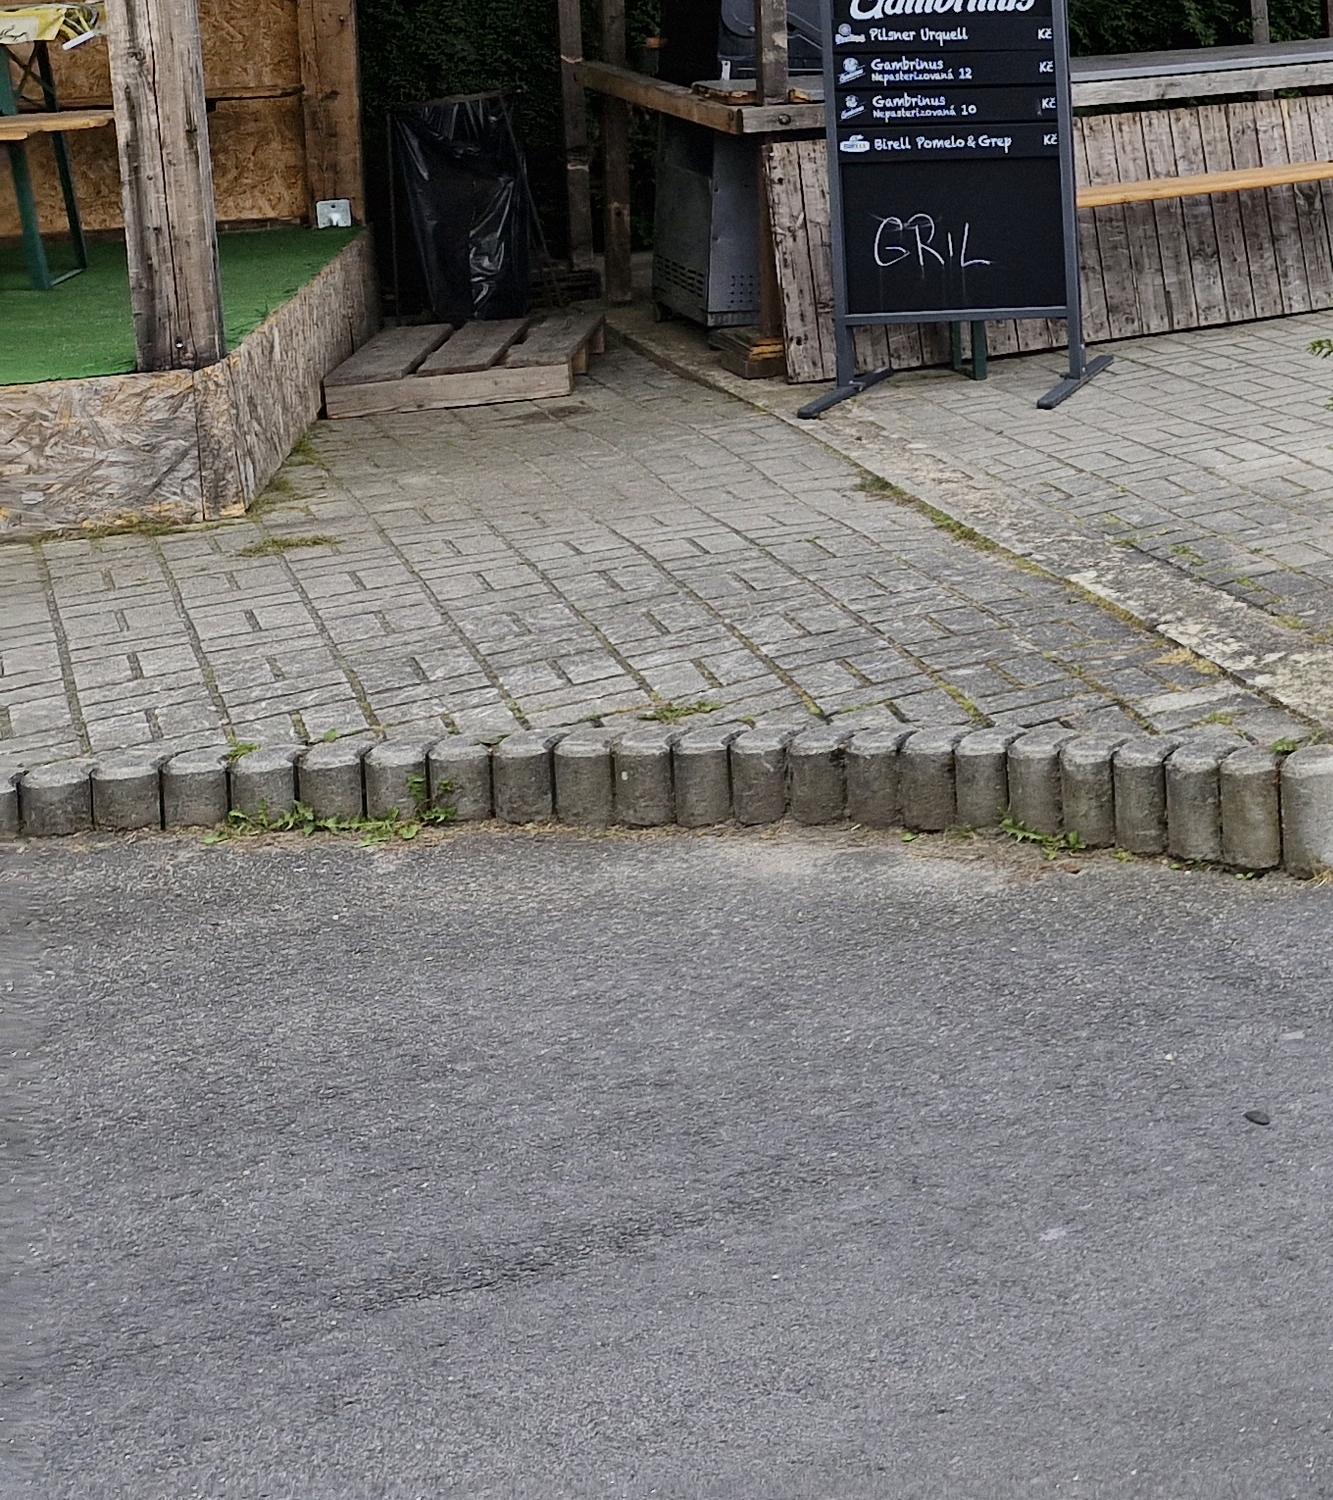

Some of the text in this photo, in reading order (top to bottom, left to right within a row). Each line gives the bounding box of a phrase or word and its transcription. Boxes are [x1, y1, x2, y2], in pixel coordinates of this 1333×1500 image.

[869, 27, 916, 42] Pilsner
[920, 27, 969, 47] Urquell
[1037, 28, 1053, 41] Kč
[870, 56, 944, 71] Gambrinus
[1039, 60, 1054, 73] Kč
[871, 68, 954, 86] Nepasterizovaná
[958, 68, 972, 80] 12
[872, 92, 946, 108] Gambrinus
[1041, 97, 1056, 109] Kč
[872, 105, 956, 123] Nepasterizovaná
[961, 105, 977, 116] 10
[874, 133, 1058, 153] Birell Pomelo & Grep Kč
[874, 212, 992, 268] GRIL
